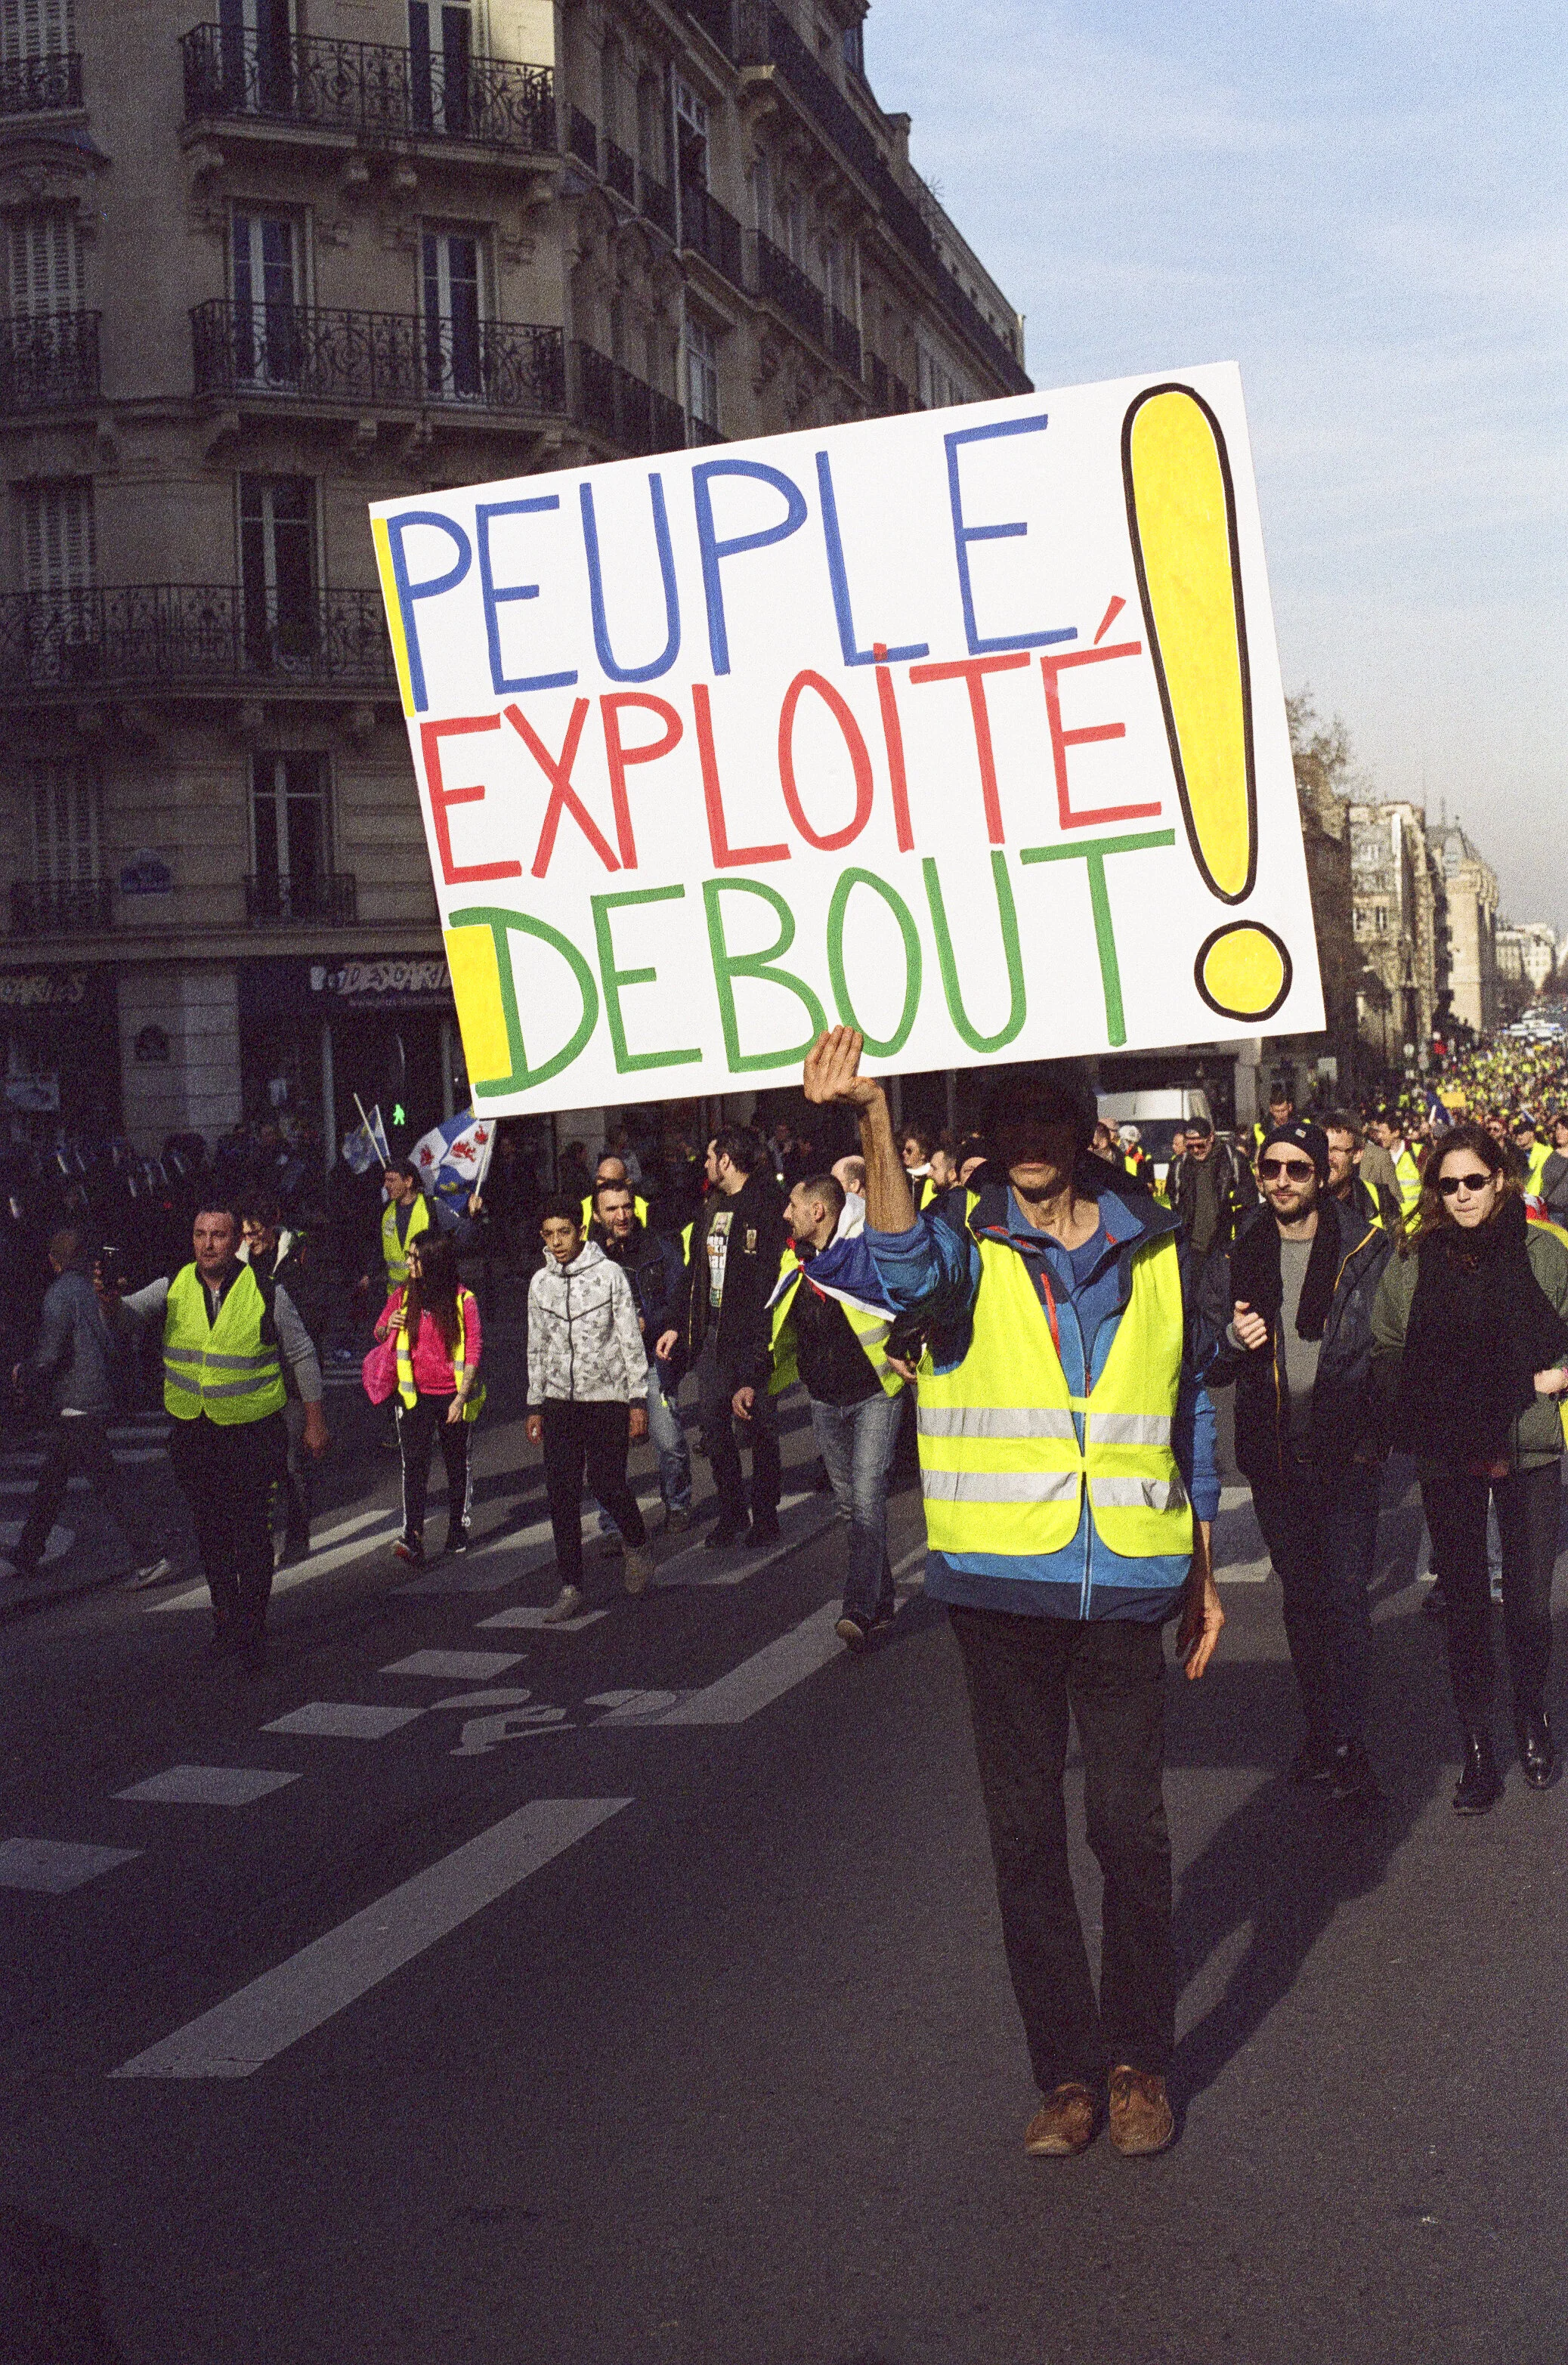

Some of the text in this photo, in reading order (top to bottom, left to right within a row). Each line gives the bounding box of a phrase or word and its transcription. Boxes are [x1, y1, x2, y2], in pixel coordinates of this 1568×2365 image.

[386, 413, 1078, 713] PEUPLE
[420, 595, 1161, 885] EXPLOITÉ
[448, 828, 1176, 1099] DEBOUT
